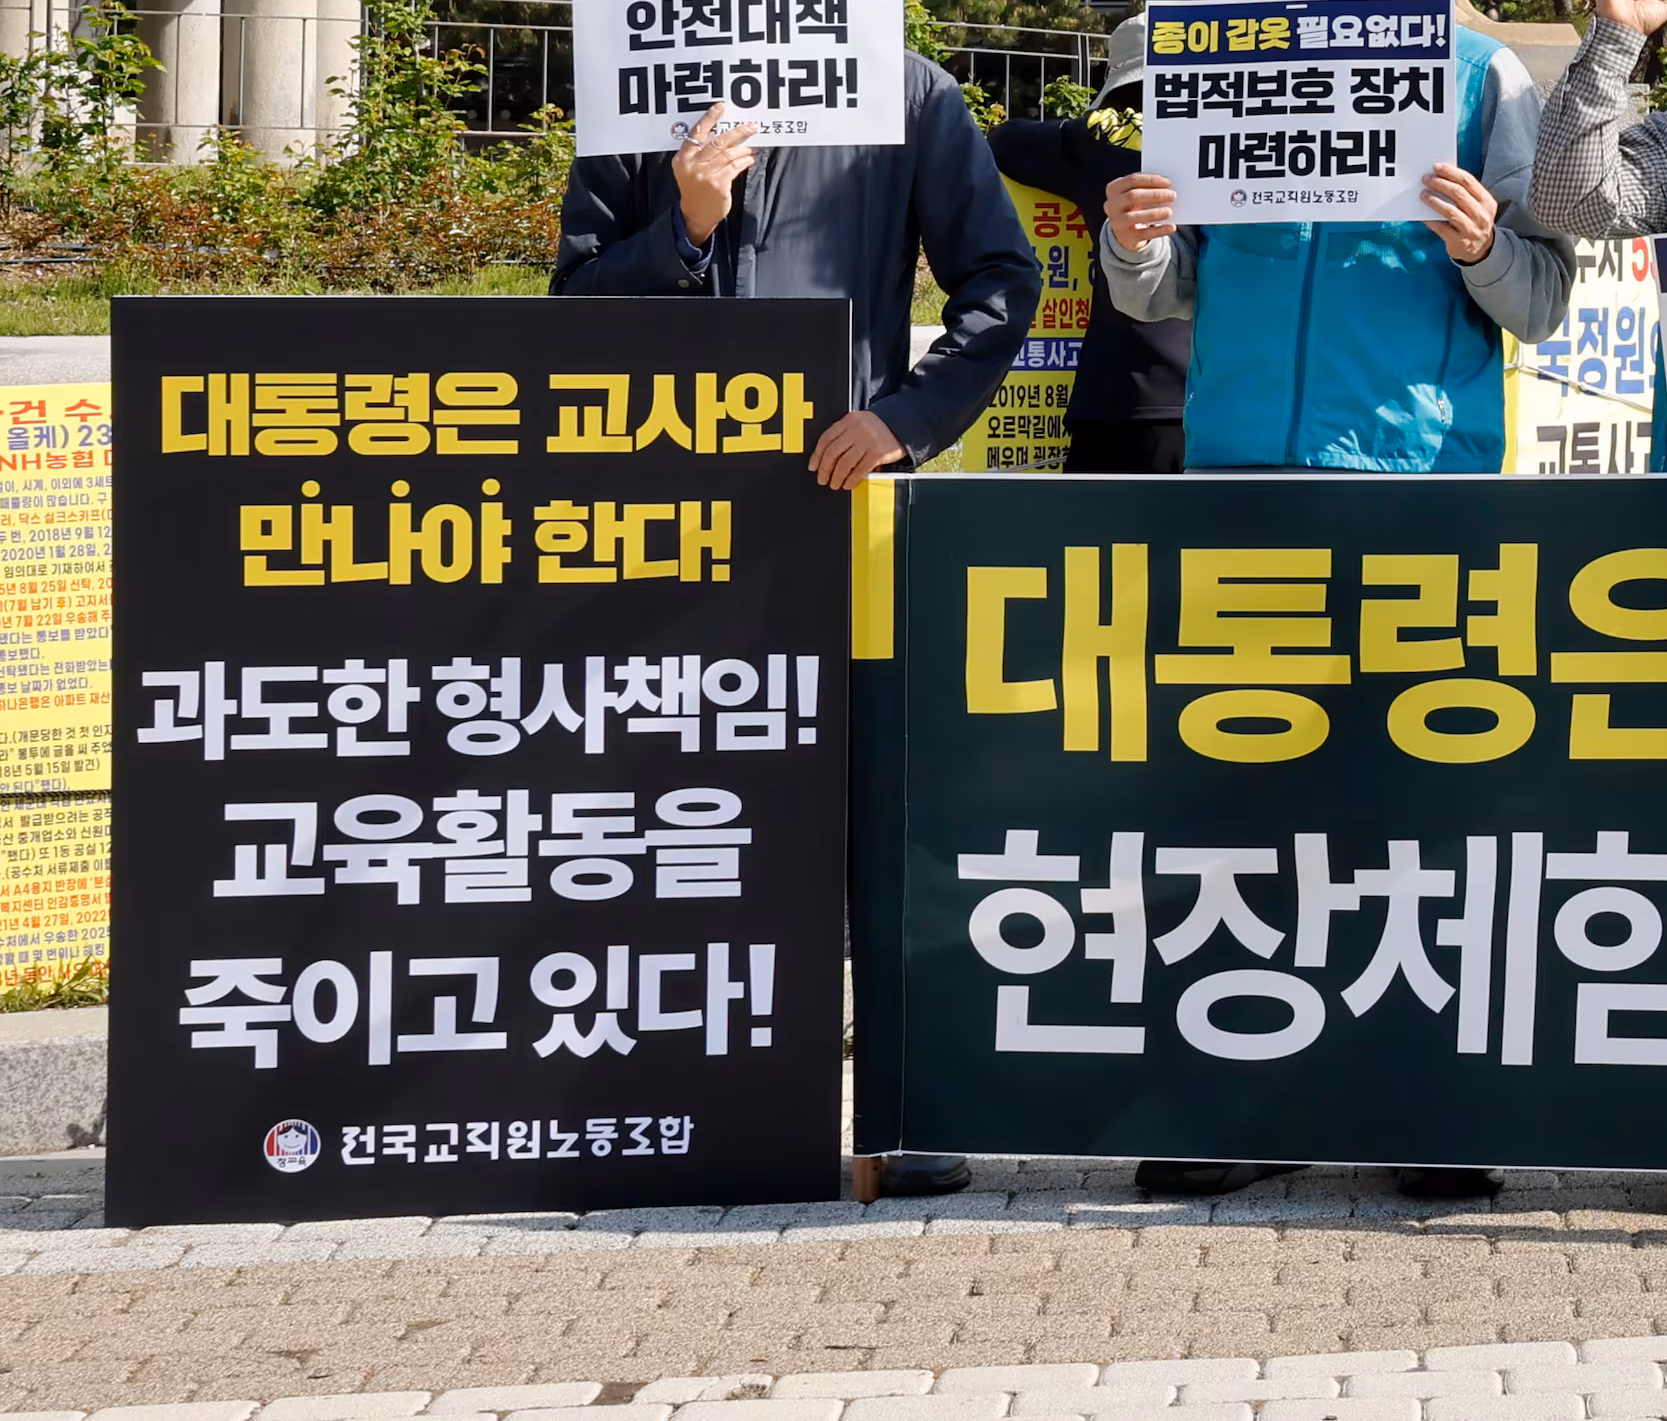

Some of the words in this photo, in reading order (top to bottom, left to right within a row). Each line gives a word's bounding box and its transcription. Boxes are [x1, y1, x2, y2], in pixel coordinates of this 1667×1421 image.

[1152, 20, 1219, 55] 종이
[1226, 16, 1291, 51] 갑옷
[1297, 14, 1447, 50] 필요없다!
[618, 58, 858, 115] 마련하라!
[1154, 68, 1335, 119] 법적보호
[1350, 67, 1445, 114] 장치
[1198, 129, 1396, 180] 마련하라!
[1252, 190, 1358, 204] 전국교직원노동조합
[161, 371, 521, 458] 대통령은
[545, 370, 815, 458] 교사와
[988, 415, 1072, 439] 오르막길에
[29, 528, 72, 543] 2018년
[238, 497, 514, 588] 만나야
[533, 497, 733, 585] 한다!
[136, 656, 421, 762] 과도한
[432, 653, 820, 758] 형사책임!
[212, 787, 753, 906] 교육활동을
[179, 949, 508, 1070] 죽이고
[529, 943, 777, 1059] 있다!
[339, 1114, 695, 1167] 전국교직원노동조합
